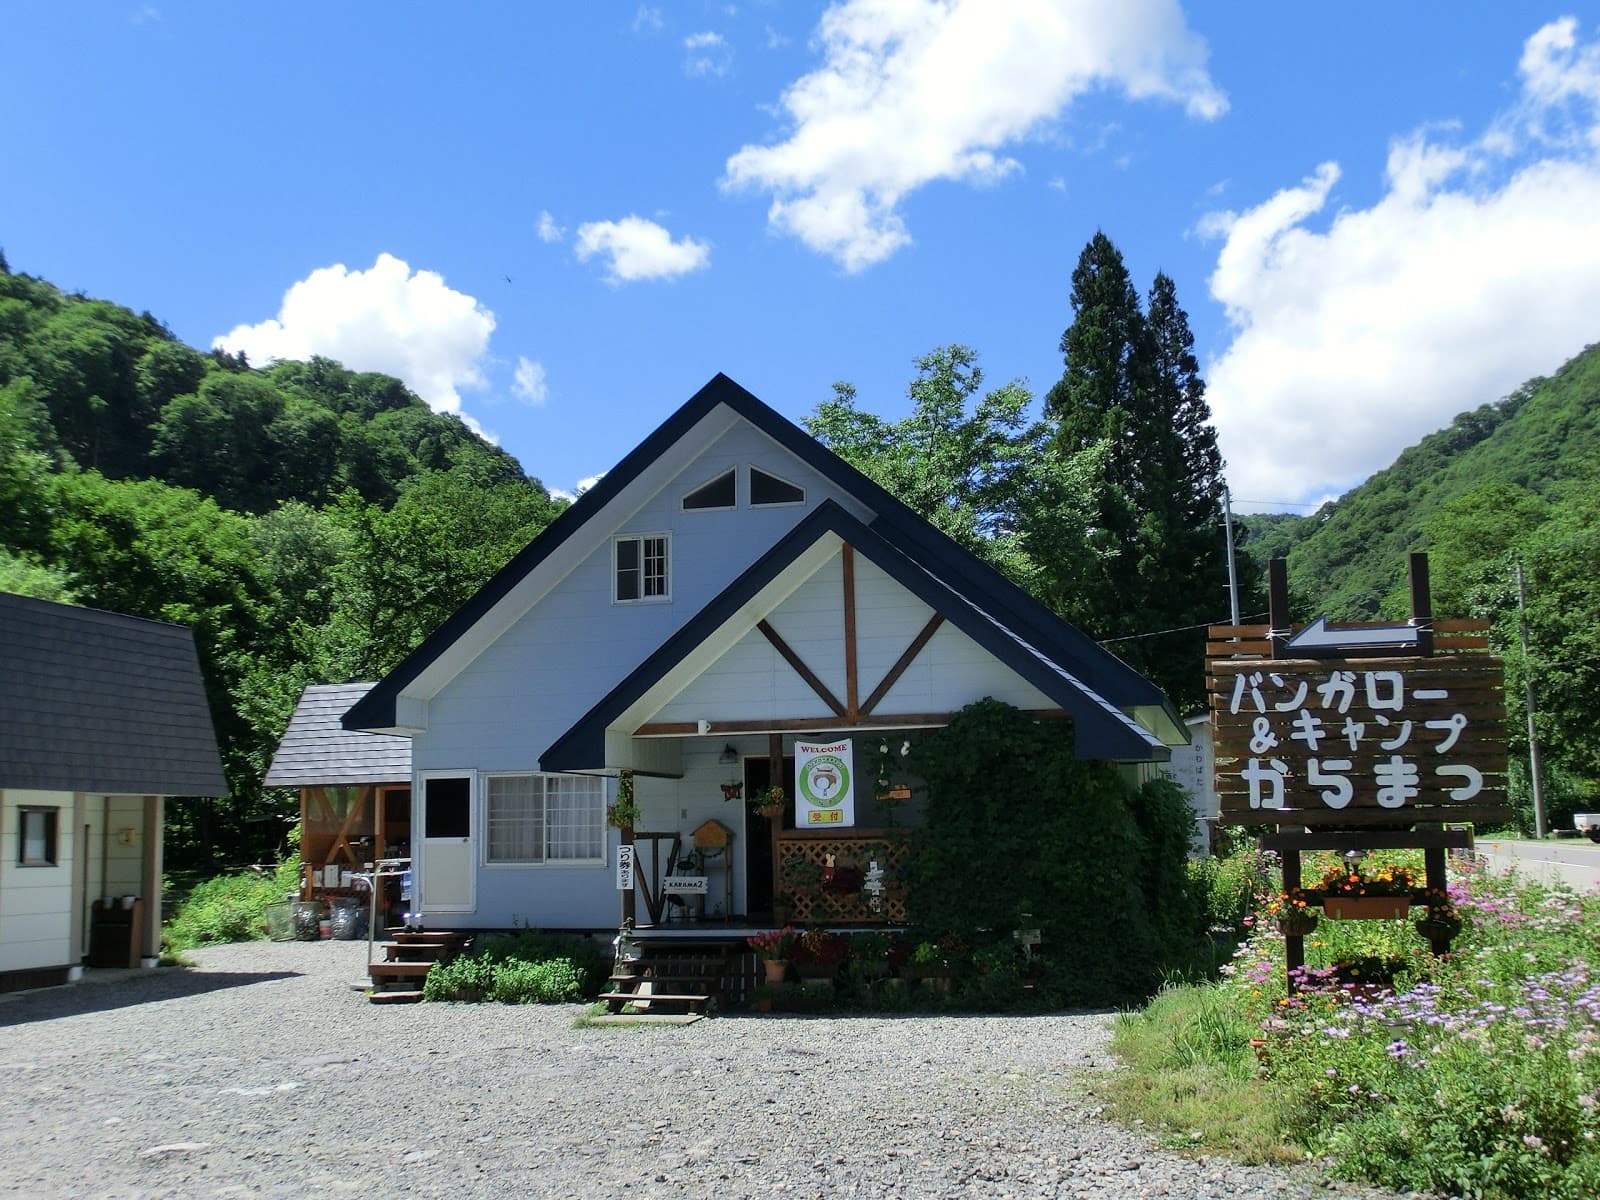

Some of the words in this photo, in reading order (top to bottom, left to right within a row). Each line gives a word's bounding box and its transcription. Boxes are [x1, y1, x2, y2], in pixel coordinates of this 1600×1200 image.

[1230, 671, 1449, 715] バンガロー
[801, 743, 847, 753] WELCOME
[1241, 755, 1484, 809] からまつ
[811, 812, 838, 822] 受付
